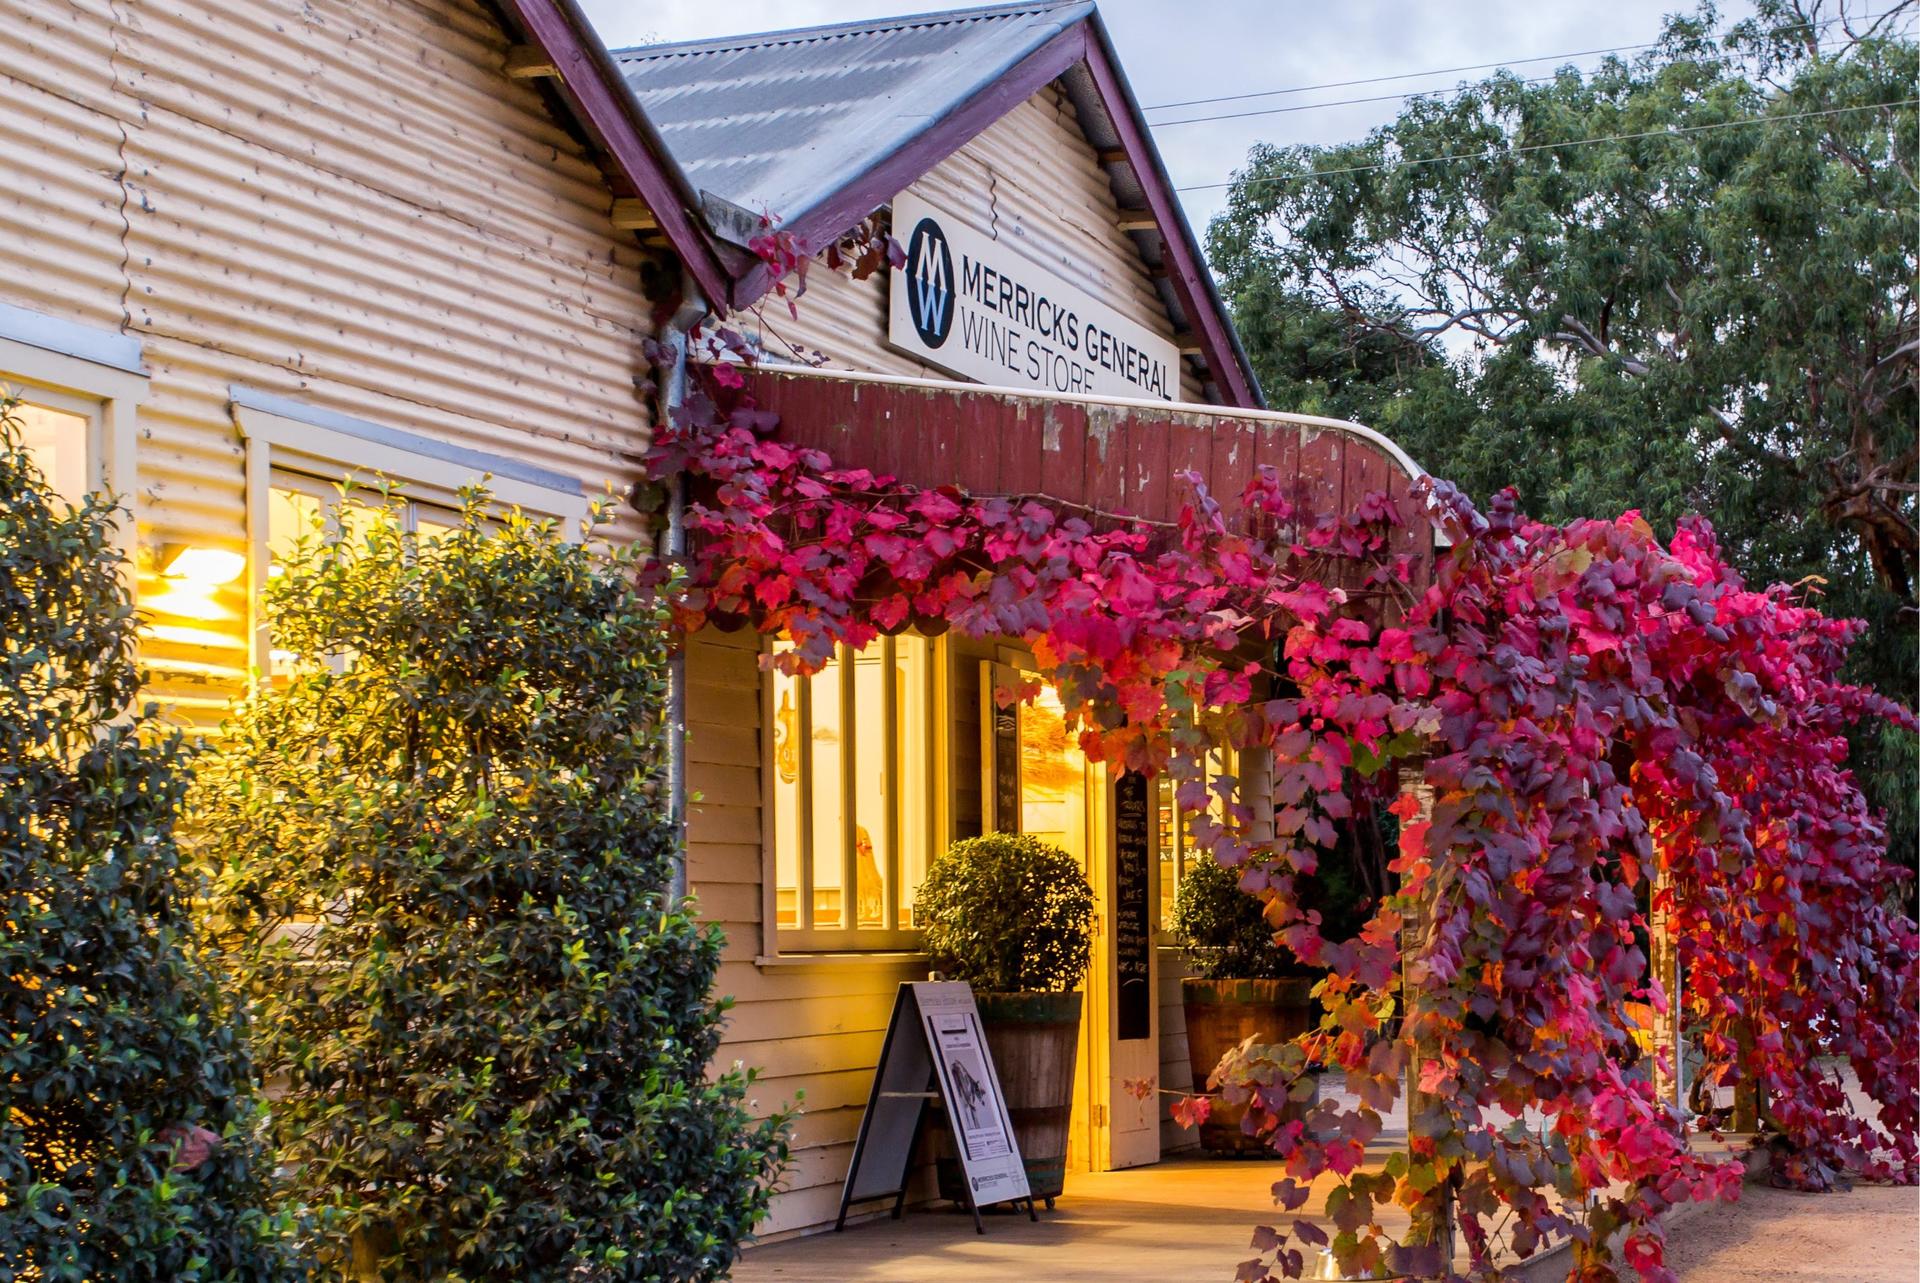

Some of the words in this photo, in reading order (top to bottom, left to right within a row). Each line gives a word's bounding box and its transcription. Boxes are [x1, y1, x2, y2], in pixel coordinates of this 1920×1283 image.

[961, 306, 1020, 373] WINE
[963, 254, 1078, 350] MERRICKS
[1085, 323, 1172, 401] GENERAL
